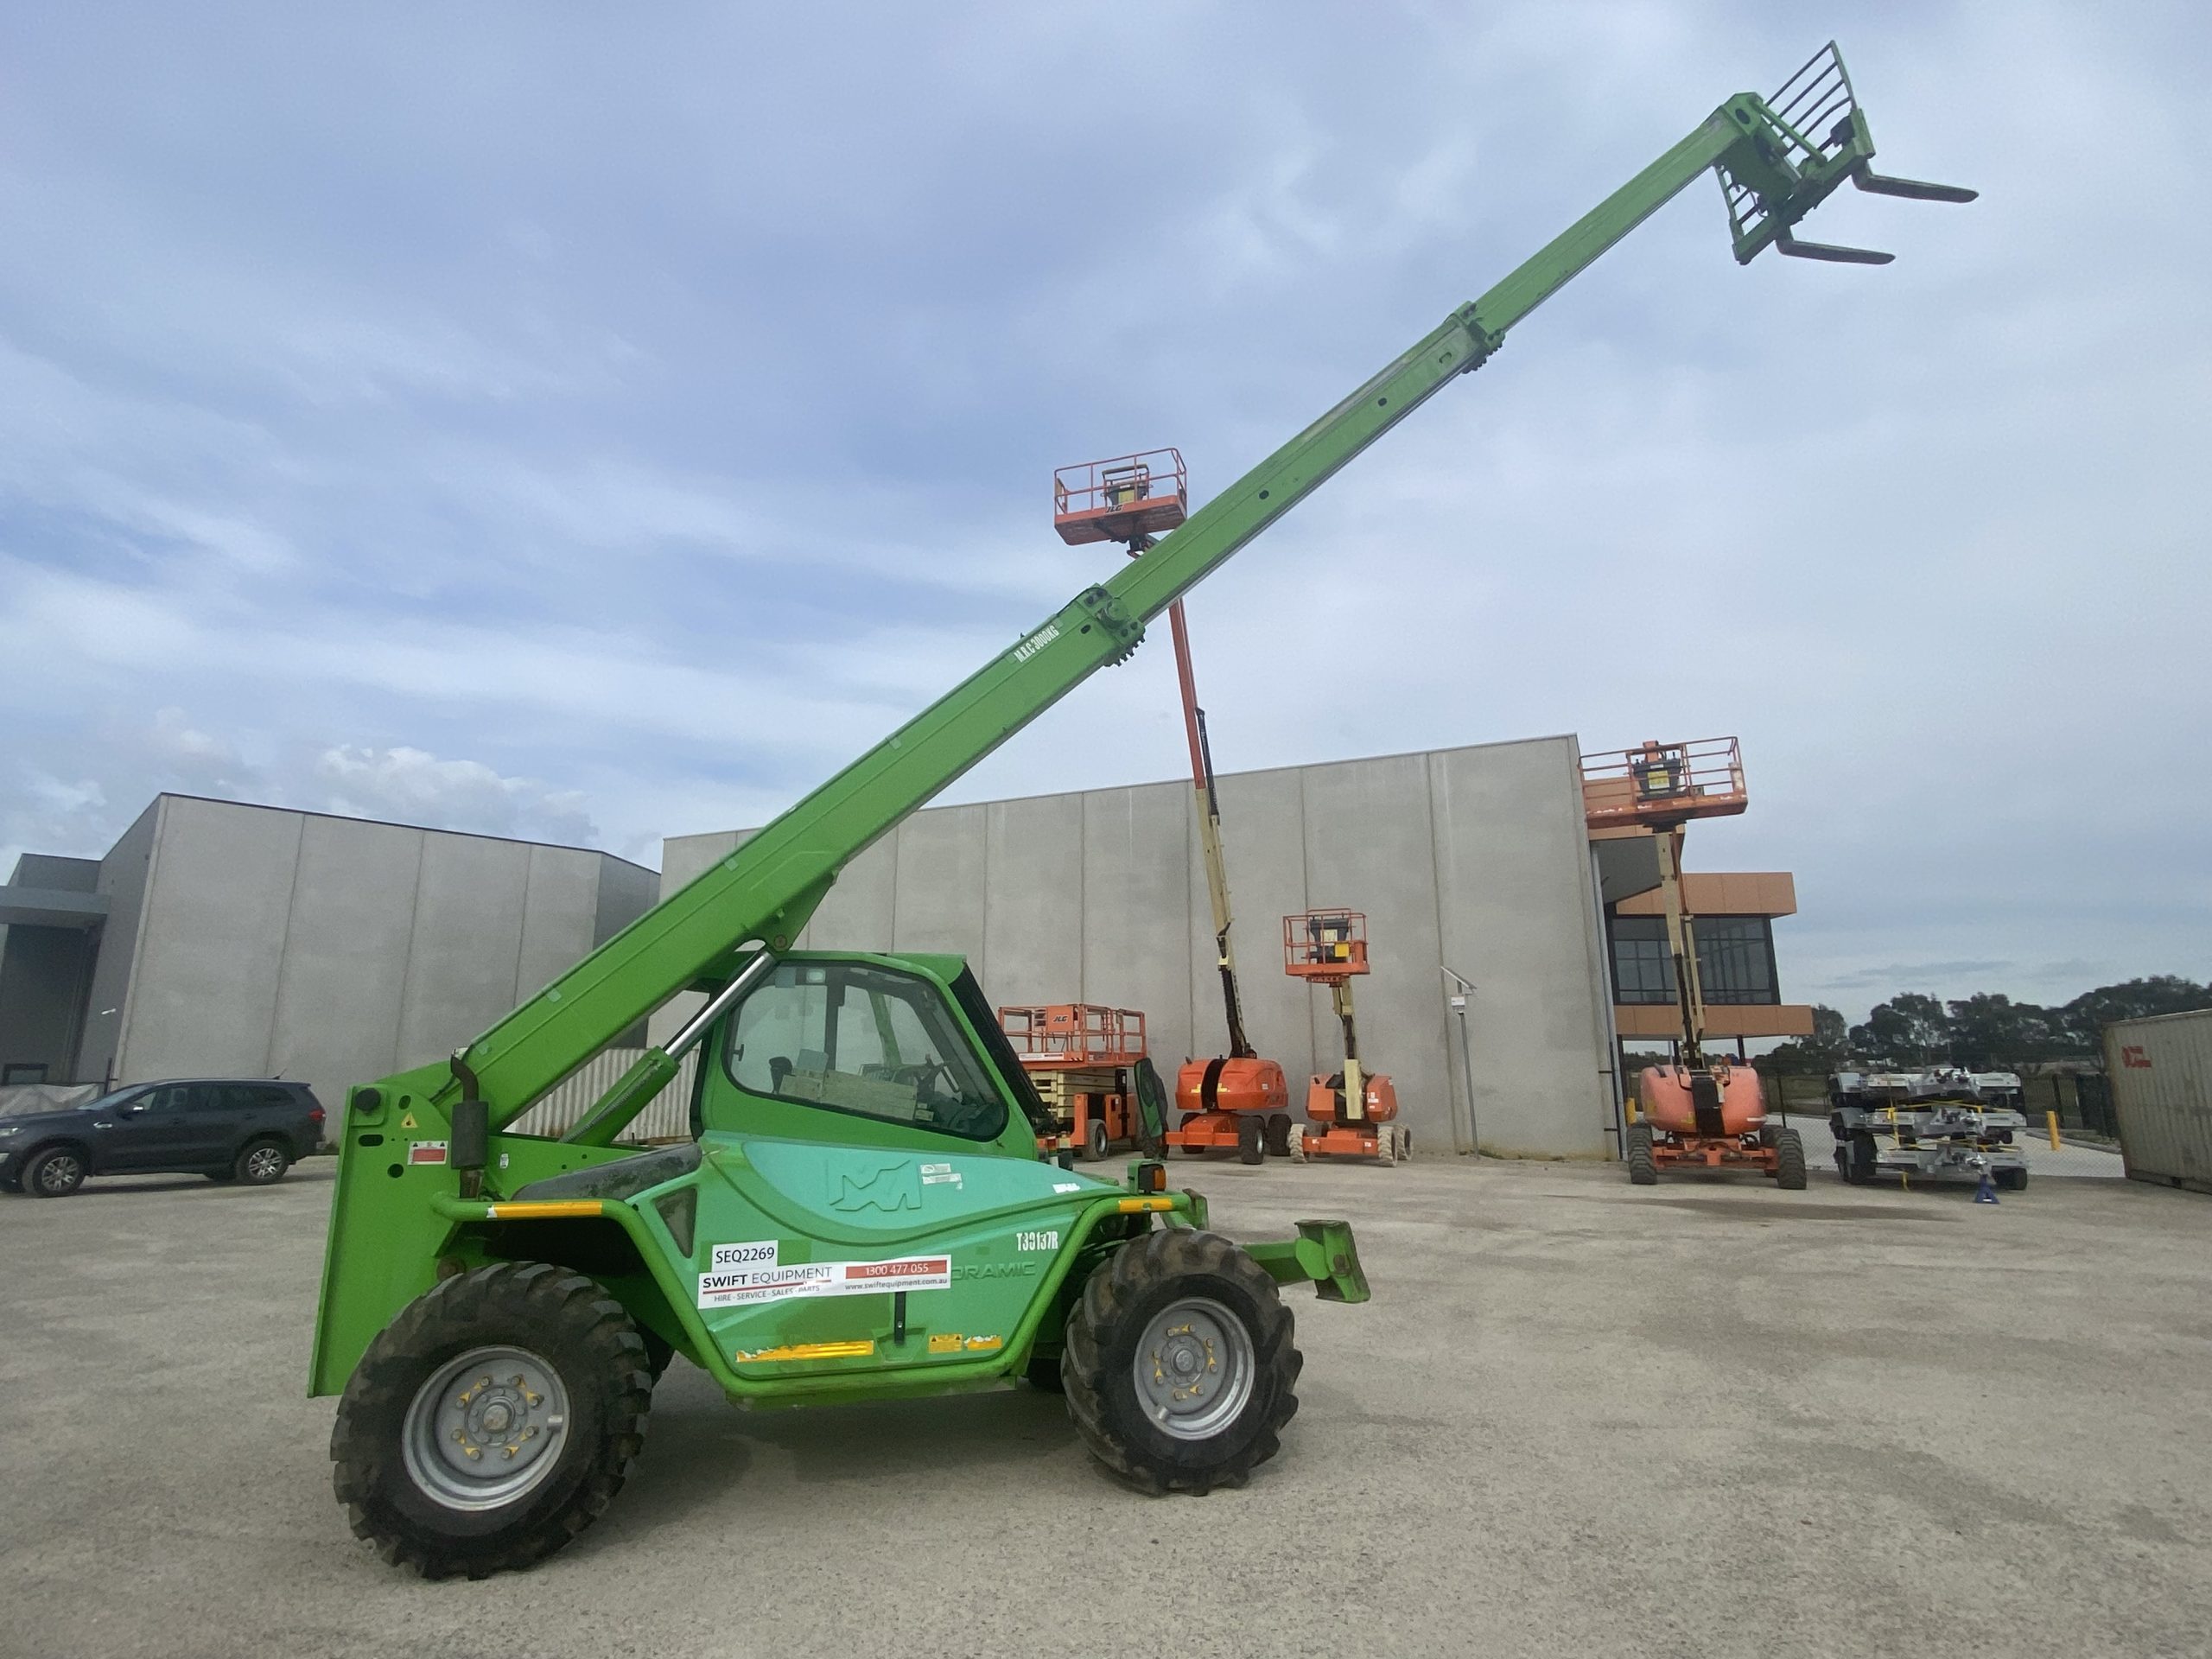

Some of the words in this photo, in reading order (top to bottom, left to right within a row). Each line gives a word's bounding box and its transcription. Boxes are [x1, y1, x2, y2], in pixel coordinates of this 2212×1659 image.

[1031, 625, 1060, 651] 3000KG
[715, 1247, 775, 1264] SEQ2269
[702, 1274, 748, 1288] SWIFT
[752, 1267, 832, 1285] EQUIPMENT
[866, 1264, 887, 1276] 1300
[890, 1264, 907, 1274] 477
[911, 1263, 929, 1274] 055
[845, 1278, 948, 1291] www.swiftequipment.com.au
[714, 1292, 731, 1302] HIRE
[736, 1290, 766, 1300] SERVICE
[772, 1287, 793, 1297] SALES
